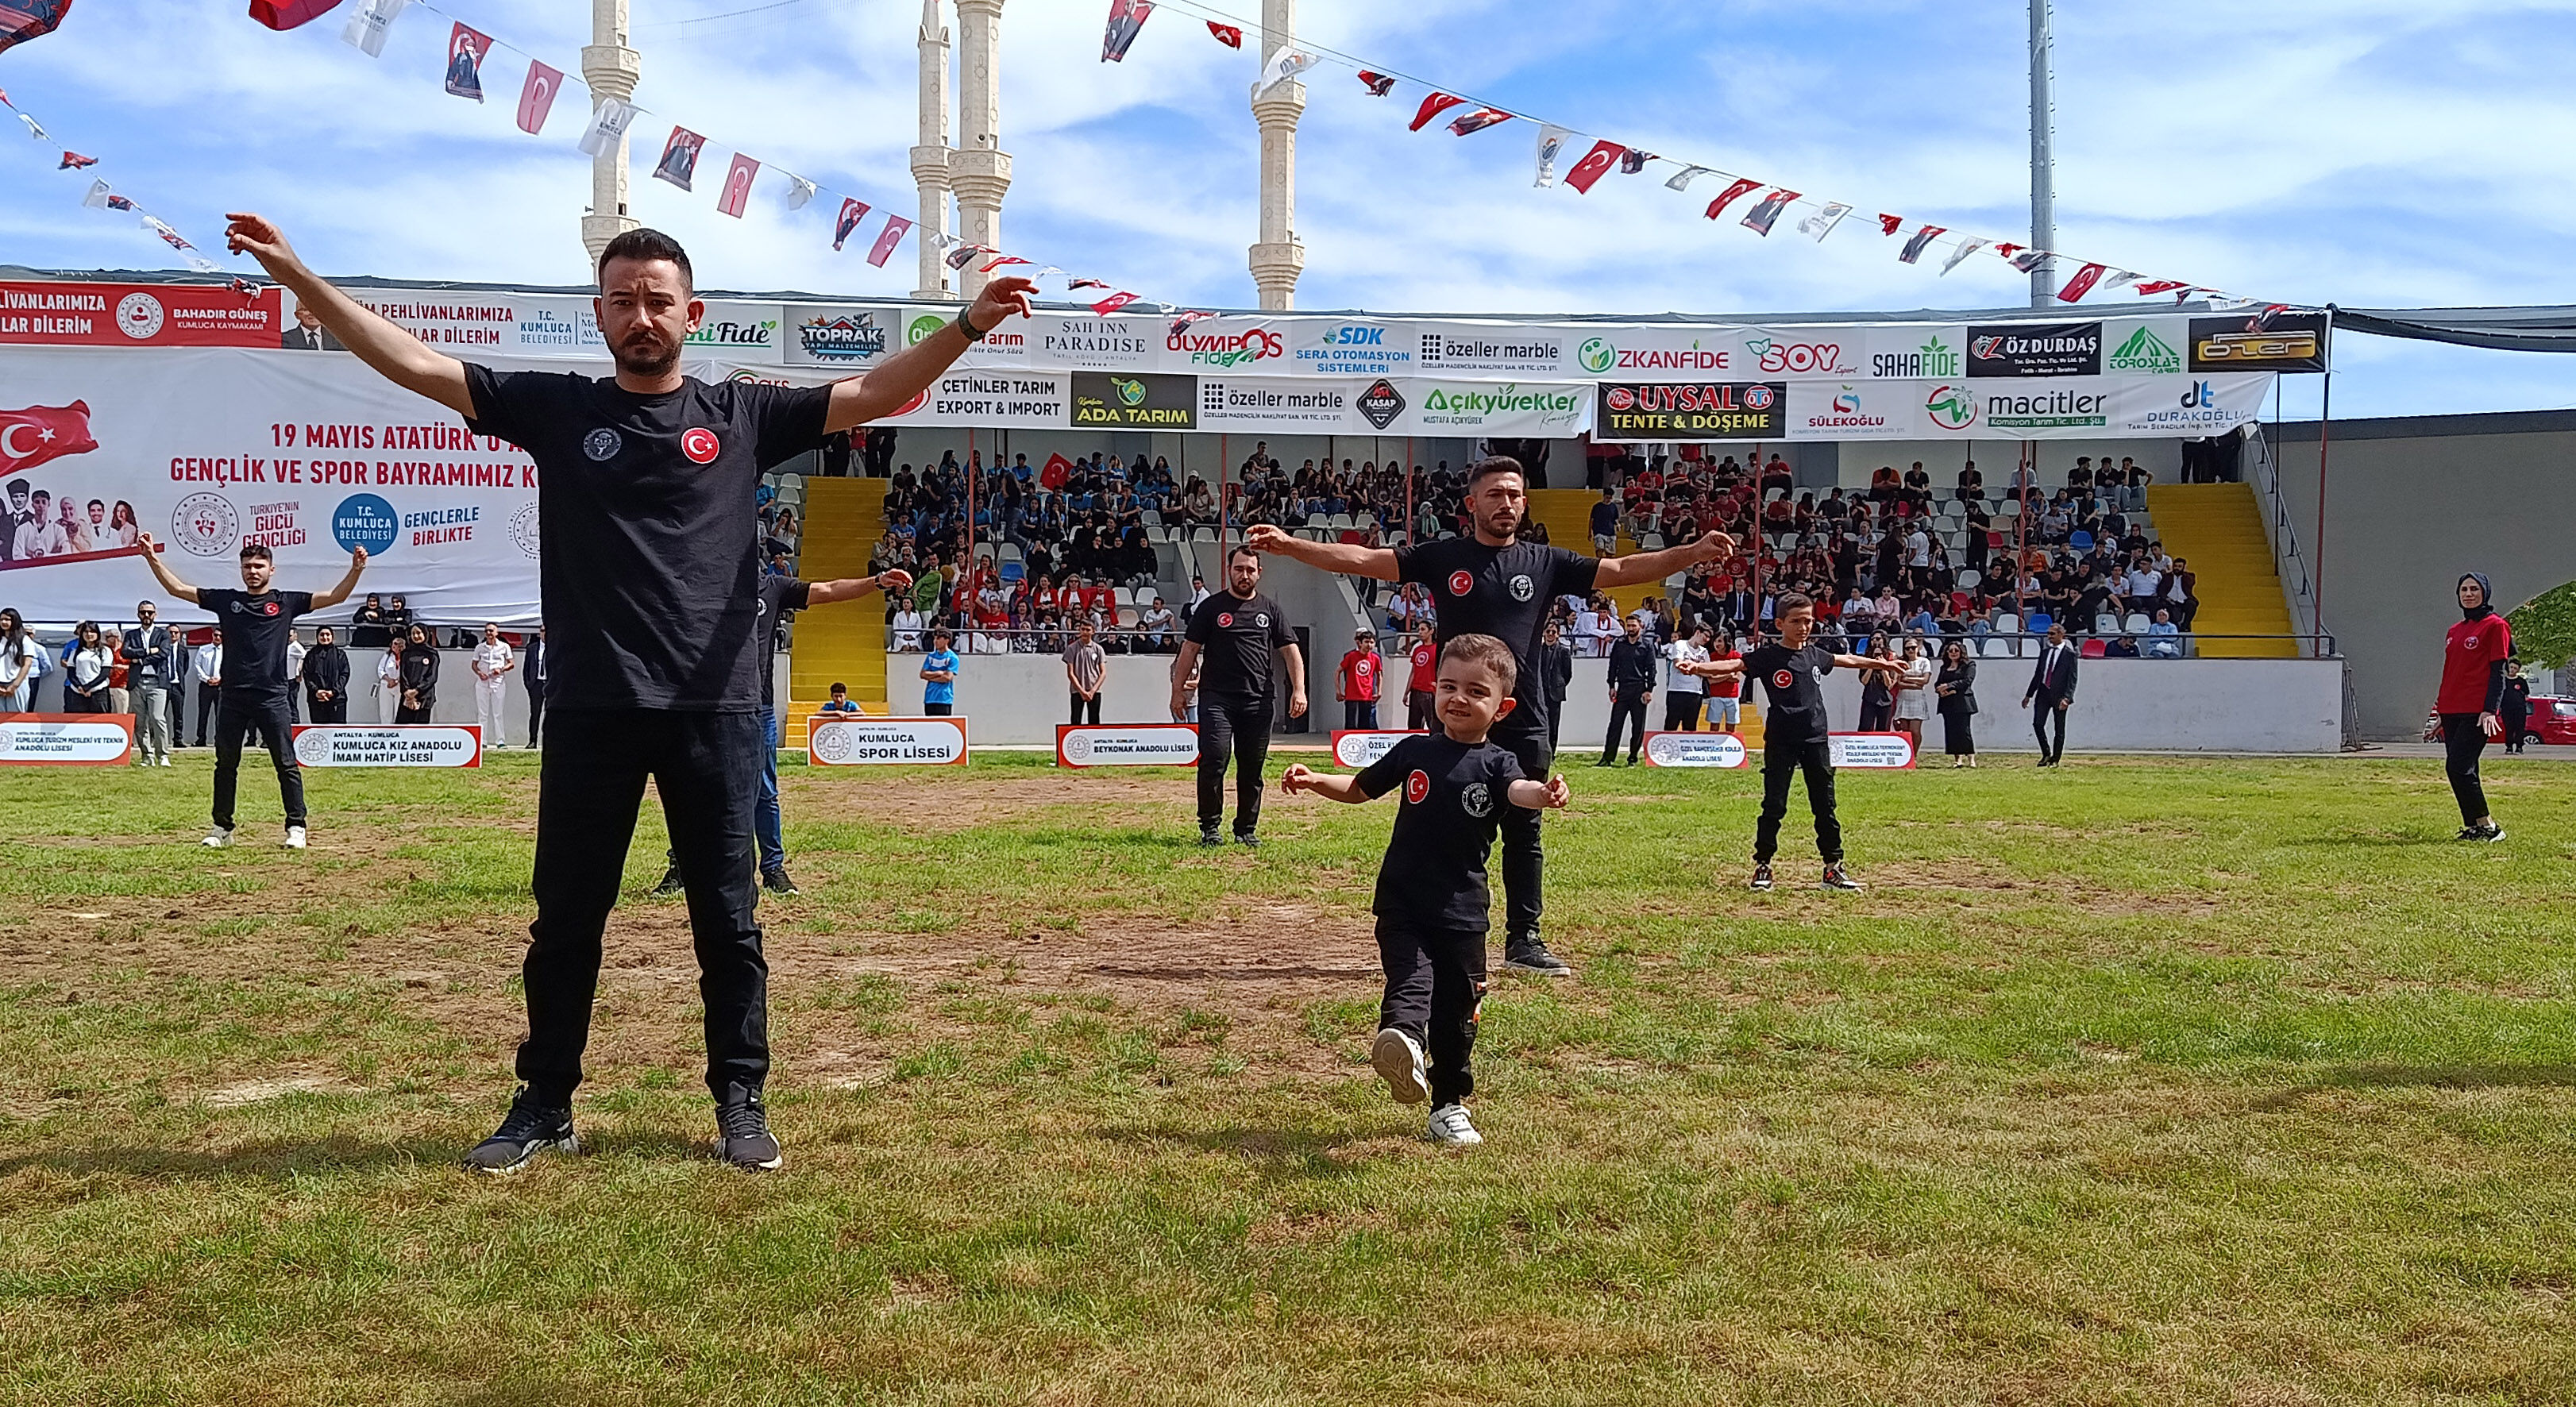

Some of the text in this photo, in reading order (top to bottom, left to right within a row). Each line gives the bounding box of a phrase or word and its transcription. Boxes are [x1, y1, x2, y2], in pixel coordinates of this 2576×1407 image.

[173, 307, 268, 323] BAHADIR GÜNEŞ
[381, 301, 514, 322] PEHLİVANLARIMIZA
[538, 310, 555, 321] T.C.
[33, 314, 92, 334] DİLERİM
[177, 321, 264, 330] KUMLUCA KAYMAKAMI
[520, 322, 573, 334] KUMLUCA
[1100, 322, 1128, 334] INN
[444, 326, 500, 345] DİLERİM
[520, 332, 572, 345] BELEDİYESİ
[805, 328, 880, 342] TOPRAK
[1338, 327, 1385, 345] SDK
[1045, 335, 1146, 353] PARADISE
[1446, 341, 1559, 358] özeller marble
[1296, 349, 1410, 361] SERA OTOMASYON
[1760, 343, 1840, 372] SOY
[1317, 362, 1389, 373] SİSTEMLERİ
[941, 376, 1055, 395] ÇETİNLER TARIM
[1228, 389, 1344, 408] özeller marble
[1639, 385, 1740, 411] UYSAL
[1988, 390, 2107, 414] macitler
[937, 400, 1061, 416] EXPORT & IMPORT
[1077, 407, 1189, 423] ADA TARIM
[1610, 411, 1769, 433] TENTE & DÖŞEME
[1809, 414, 1884, 427] SÜLEKOĞLU
[271, 422, 500, 452] 19 MAYIS ATATÜRK
[170, 453, 266, 488] GENÇLİK
[273, 459, 302, 484] VE
[310, 461, 368, 485] SPOR
[377, 462, 515, 488] BAYRAMIMIZ
[357, 506, 374, 516] T.C.
[404, 507, 480, 530] GENÇLERLE
[255, 513, 293, 532] GÜCÜ
[339, 517, 391, 529] KUMLUCA
[339, 529, 391, 541] BELEDİYESİ
[412, 526, 472, 546] BİRLİKTE
[15, 736, 44, 745] KUMLUCA
[51, 743, 73, 752] LİSESİ
[333, 741, 462, 750] KUMLUCA KIZ ANADOLU
[1170, 743, 1194, 752] LİSESİ
[332, 751, 434, 762] İMAM HATİP LİSESİ
[859, 746, 951, 759] SPOR LİSESİ
